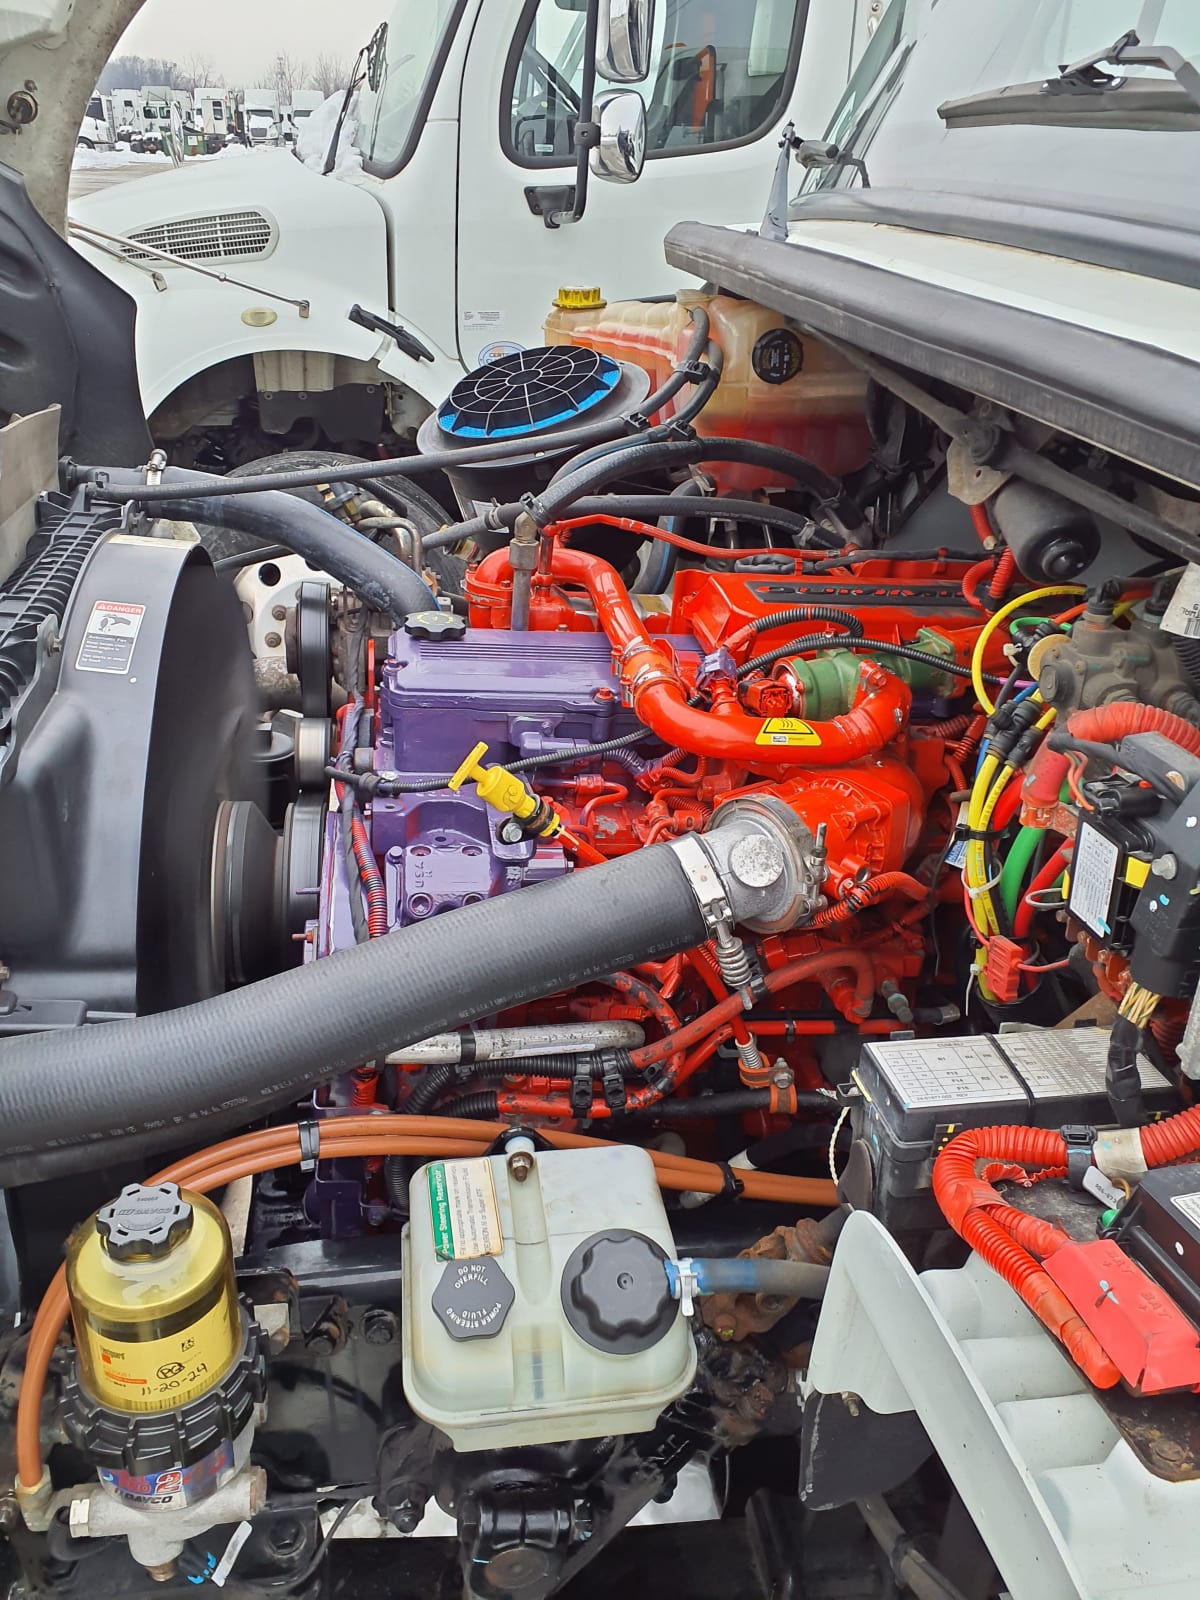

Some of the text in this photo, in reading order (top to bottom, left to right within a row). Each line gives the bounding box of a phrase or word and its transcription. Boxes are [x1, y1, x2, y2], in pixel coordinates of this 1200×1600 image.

[106, 604, 142, 614] DANGER
[434, 1170, 450, 1254] Power Steering Reservoir
[458, 1265, 486, 1275] DO NOT
[454, 1273, 488, 1288] OVERFILL
[446, 1302, 502, 1328] POWER STEERING
[462, 1308, 487, 1319] FLUID
[141, 1363, 208, 1396] 11-20-24
